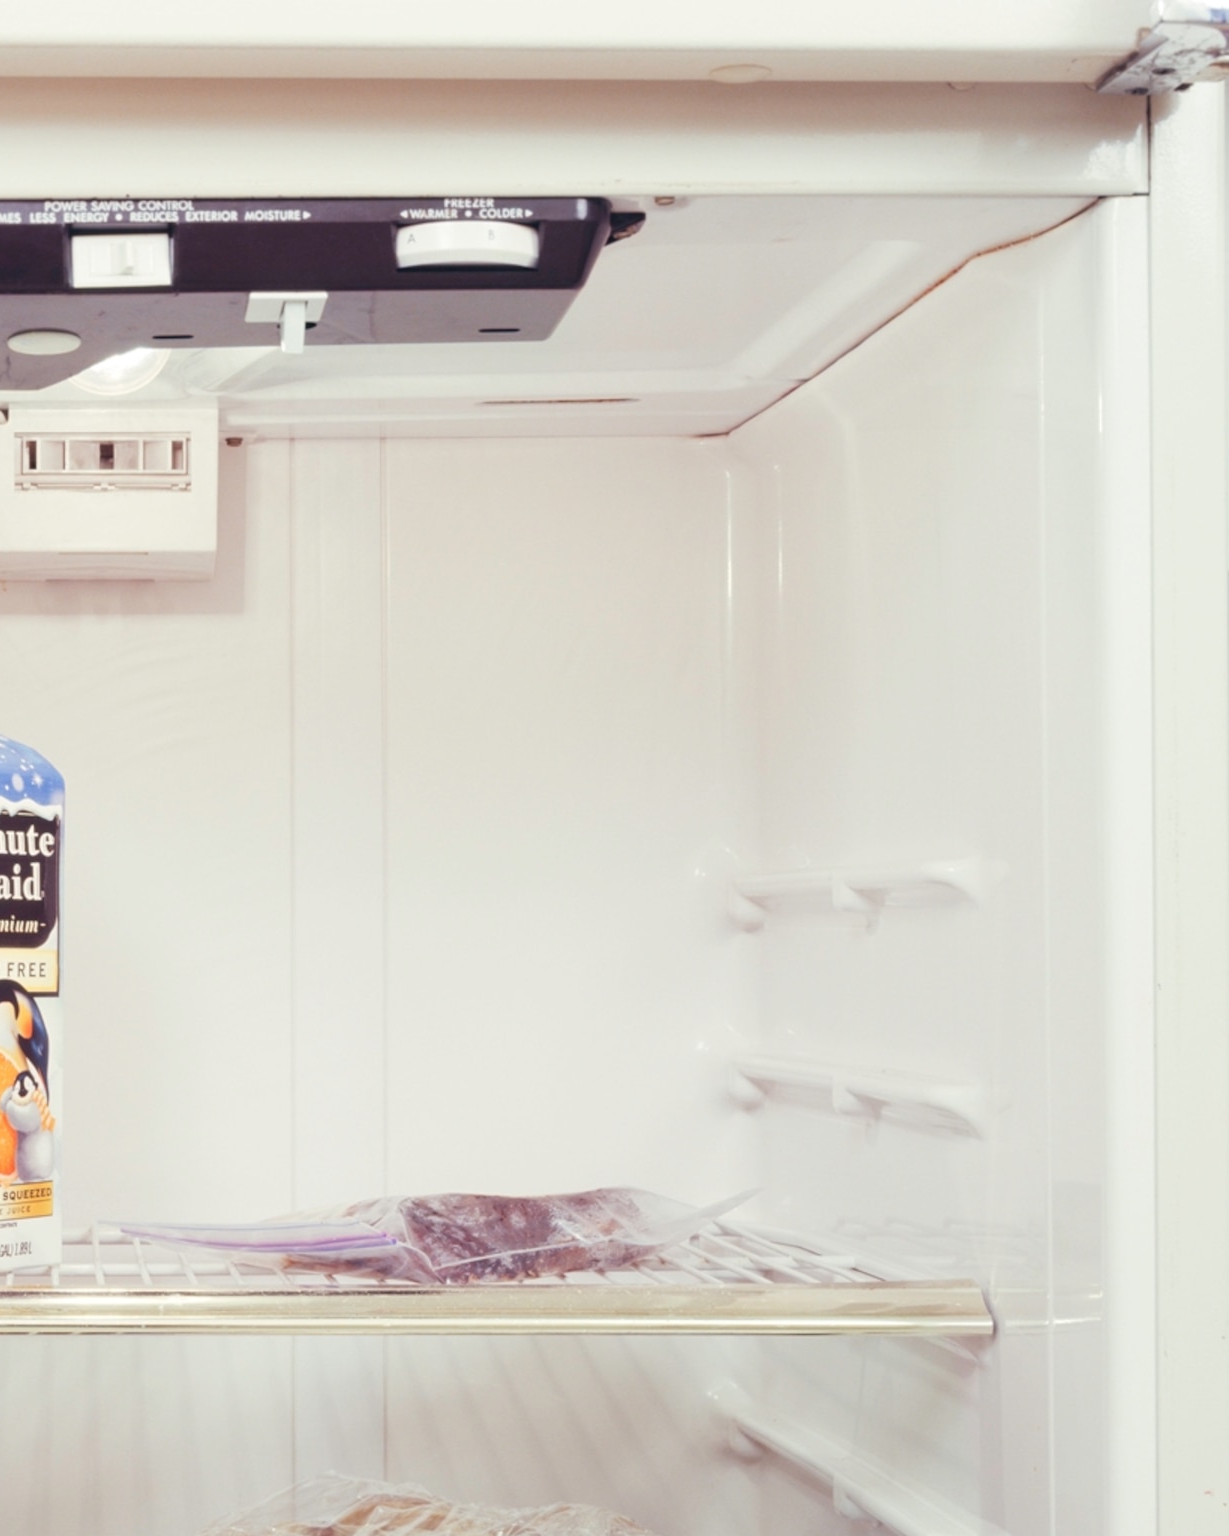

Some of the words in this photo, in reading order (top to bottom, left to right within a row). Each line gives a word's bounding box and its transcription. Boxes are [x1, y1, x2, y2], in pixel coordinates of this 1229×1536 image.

[44, 201, 88, 212] POWER
[91, 201, 135, 212] SAVING
[138, 200, 194, 211] CONTROL
[444, 198, 494, 208] FREEZER
[29, 212, 57, 223] LESS
[63, 212, 110, 223] ENERGY
[129, 211, 179, 223] REDUCES
[185, 211, 238, 222] EXTERIOR
[244, 210, 302, 221] MOISTURE
[409, 209, 458, 219] WARMER
[478, 208, 524, 219] COLDER
[407, 233, 416, 244] A
[488, 229, 496, 240] B
[7, 961, 47, 978] FREE
[3, 1187, 53, 1202] SQUEEZED
[7, 1205, 32, 1215] JUICE
